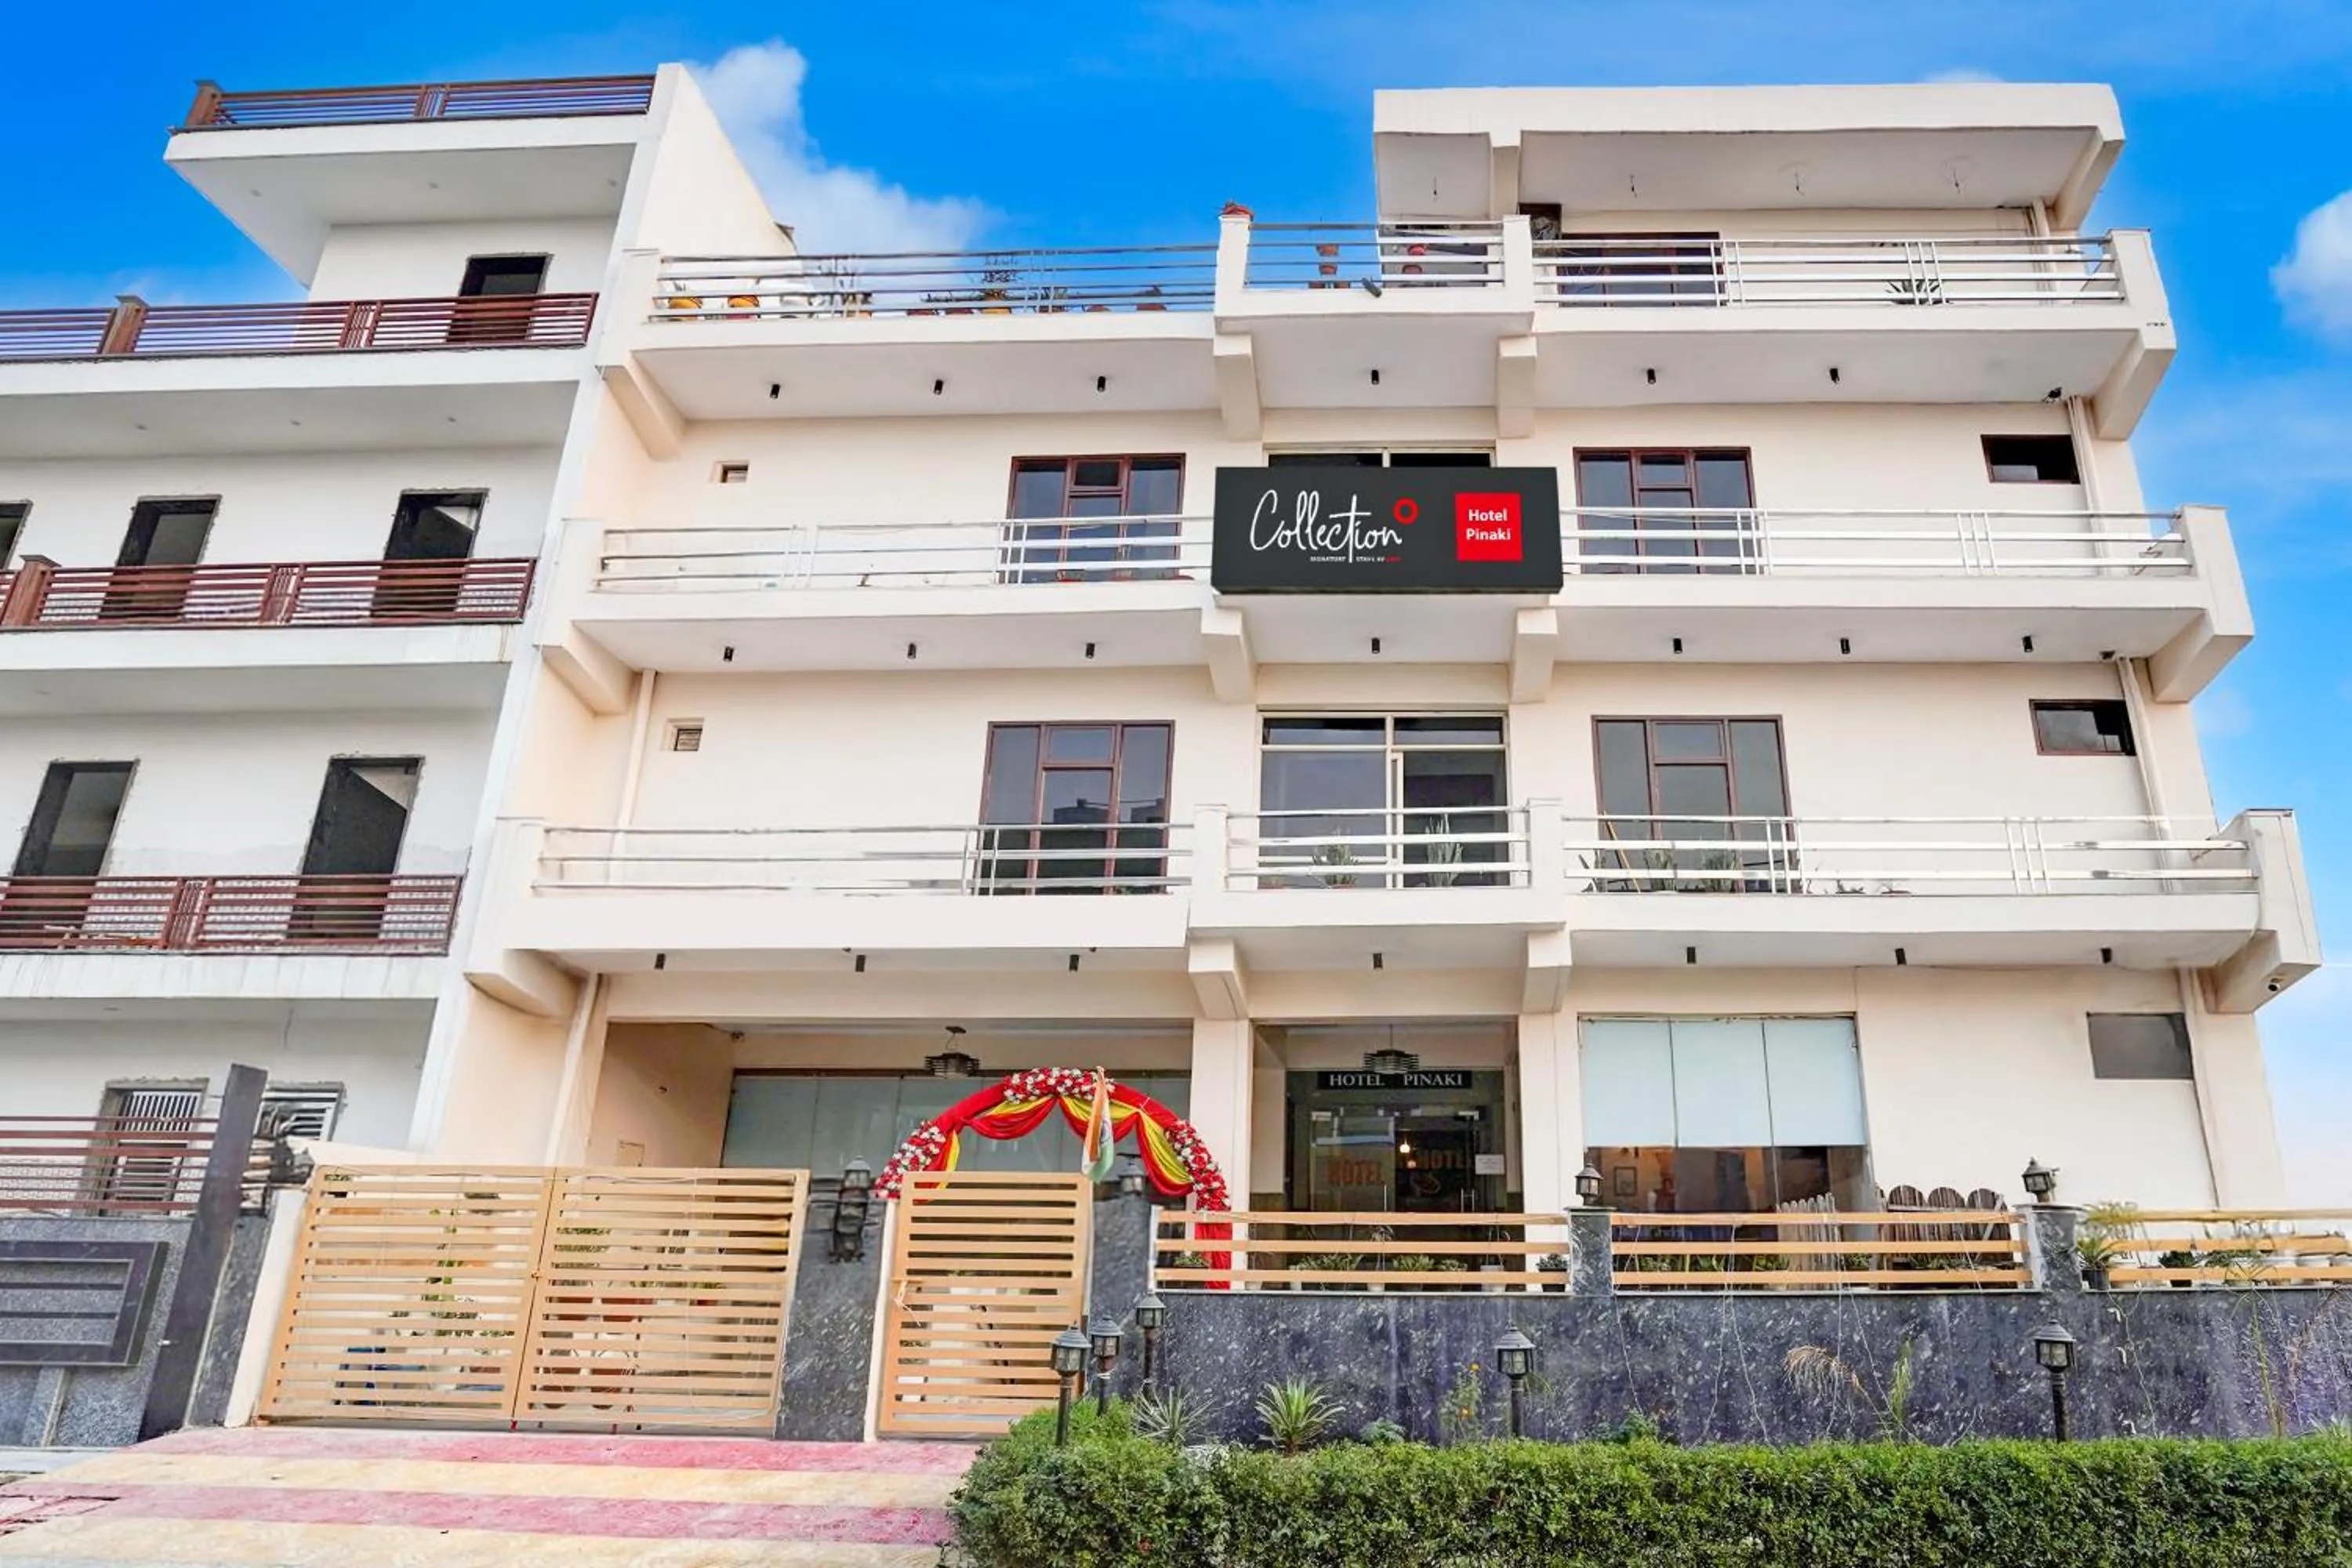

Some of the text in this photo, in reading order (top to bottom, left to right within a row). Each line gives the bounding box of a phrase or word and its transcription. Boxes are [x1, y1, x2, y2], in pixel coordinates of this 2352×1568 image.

[1468, 508, 1508, 521] Hotel
[1250, 489, 1403, 563] Collection
[1466, 528, 1511, 540] Pinaki
[1330, 1074, 1462, 1086] HOTEL PINAKI
